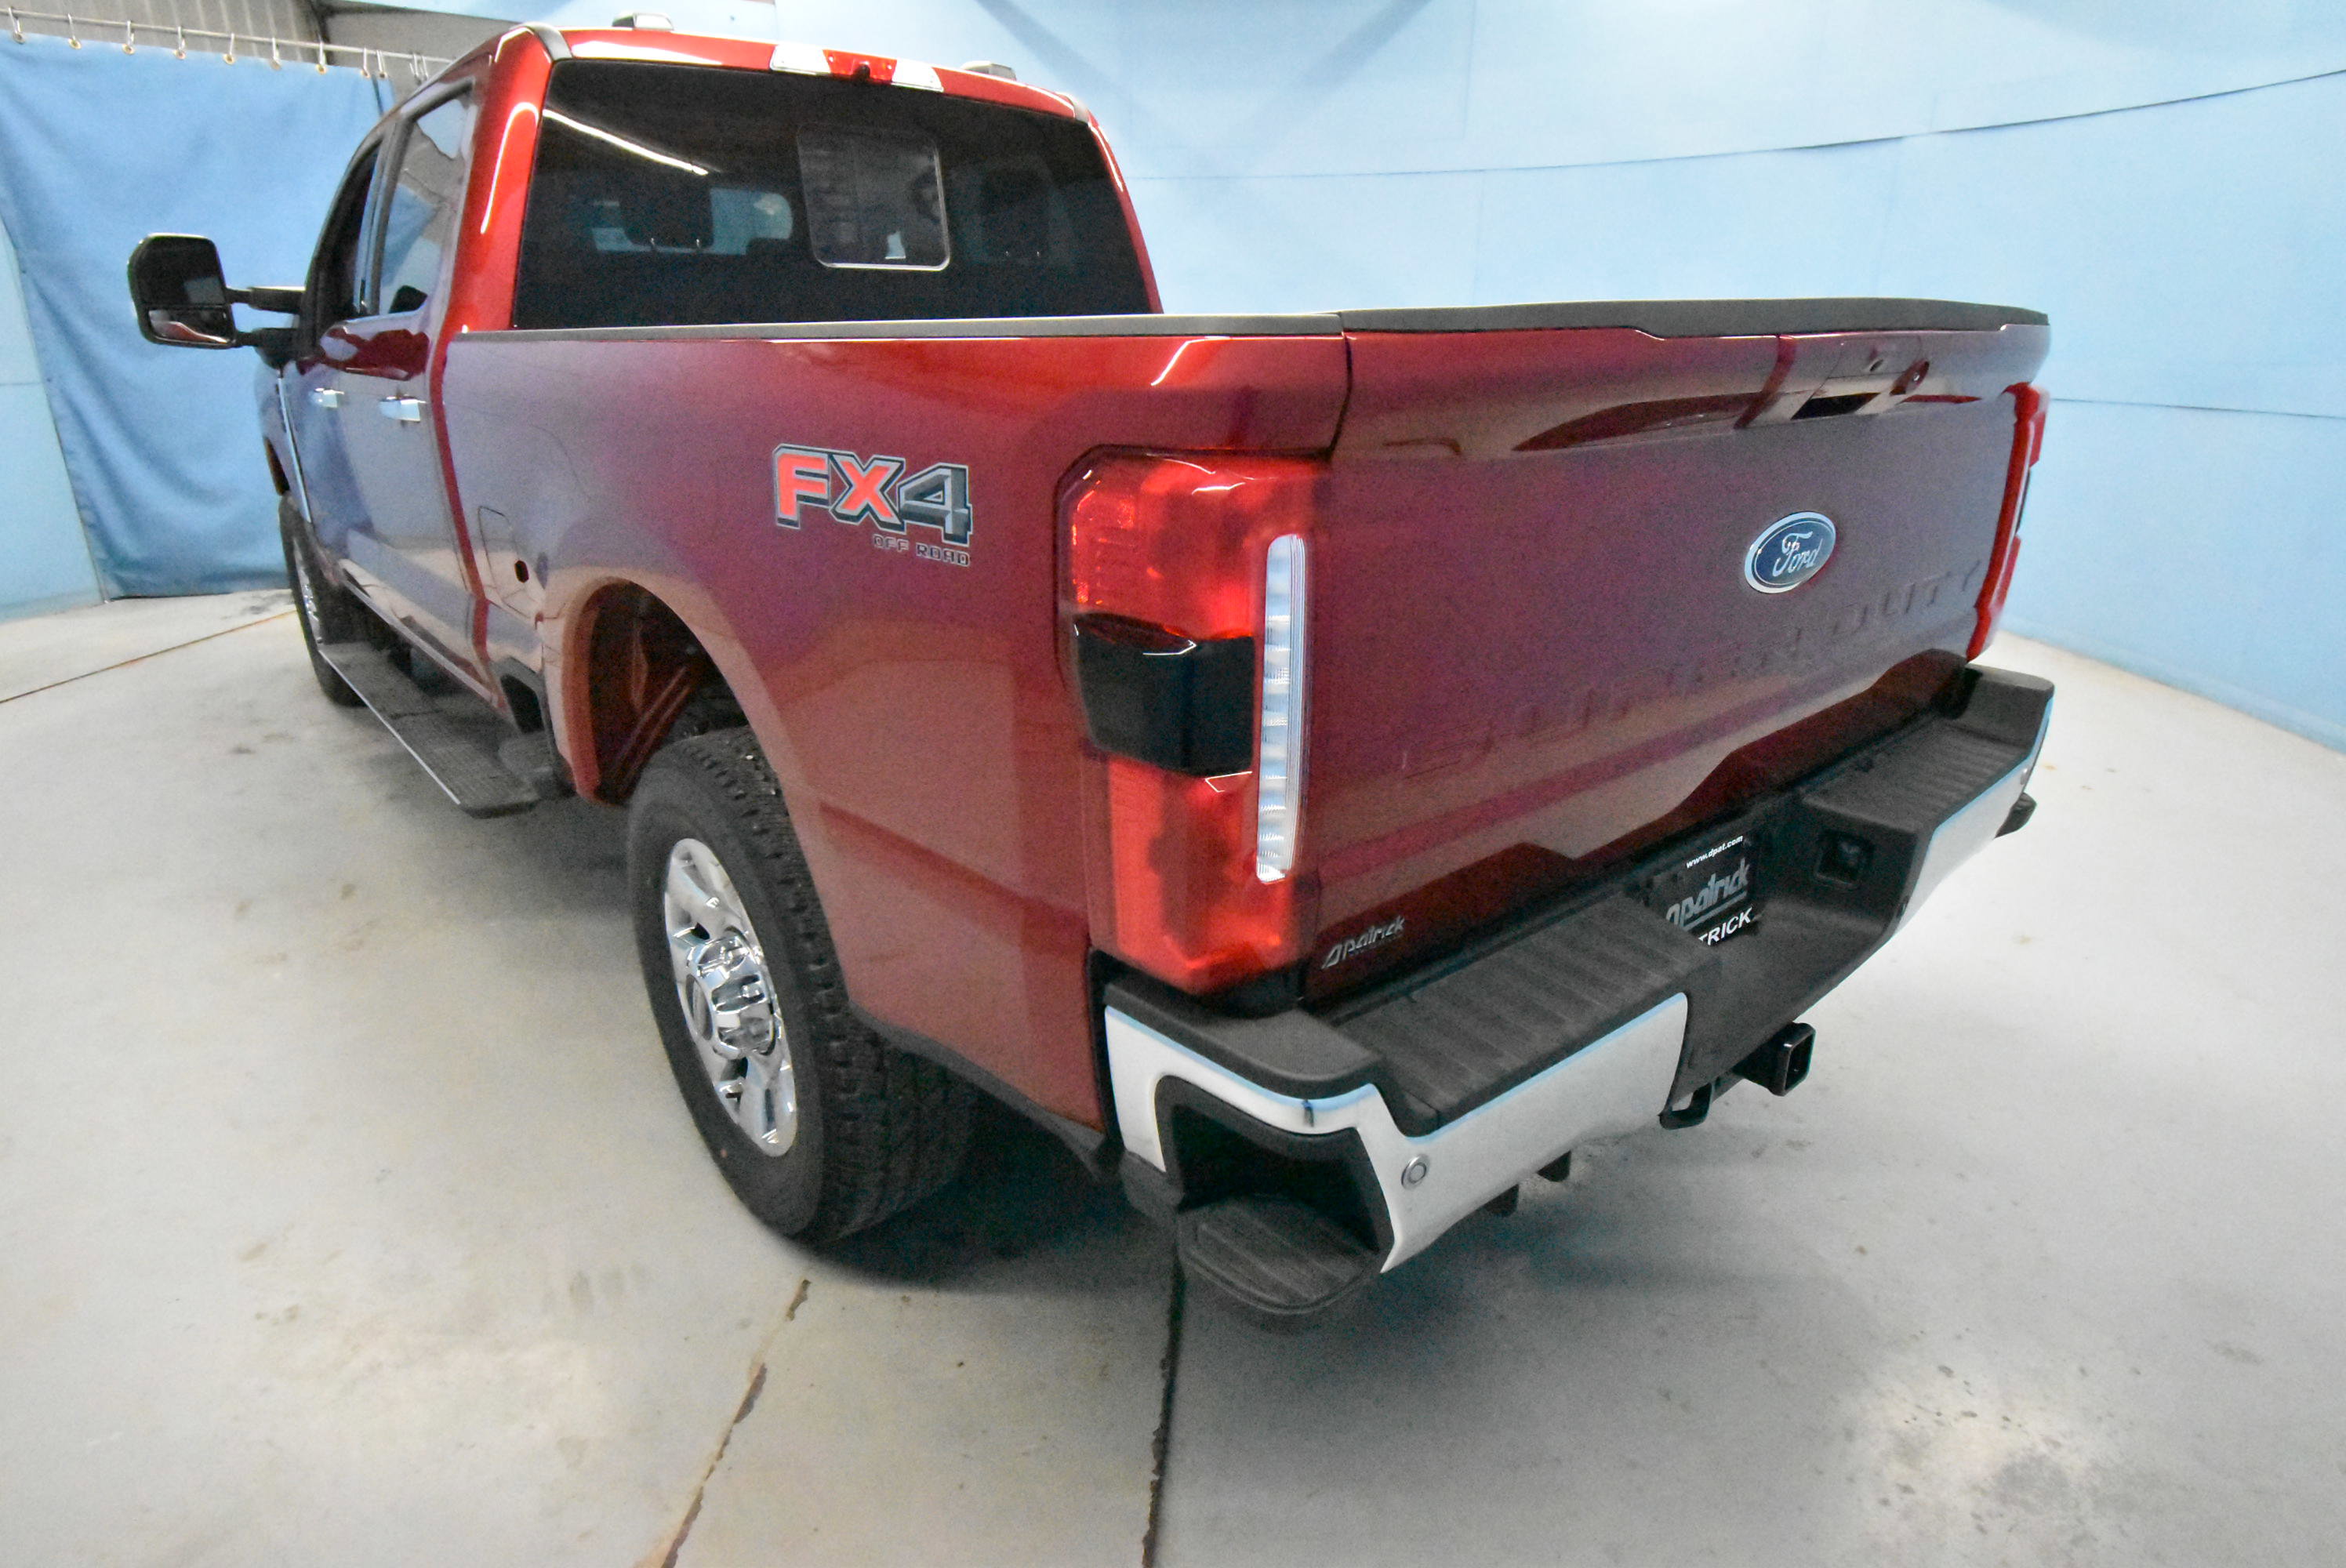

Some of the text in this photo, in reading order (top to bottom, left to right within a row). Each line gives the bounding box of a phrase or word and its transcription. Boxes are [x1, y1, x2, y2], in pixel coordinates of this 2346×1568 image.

[772, 443, 972, 547] FX4
[873, 533, 971, 567] OFF ROAD
[1772, 531, 1823, 577] Ford
[1686, 835, 1744, 869] www.dpat.com
